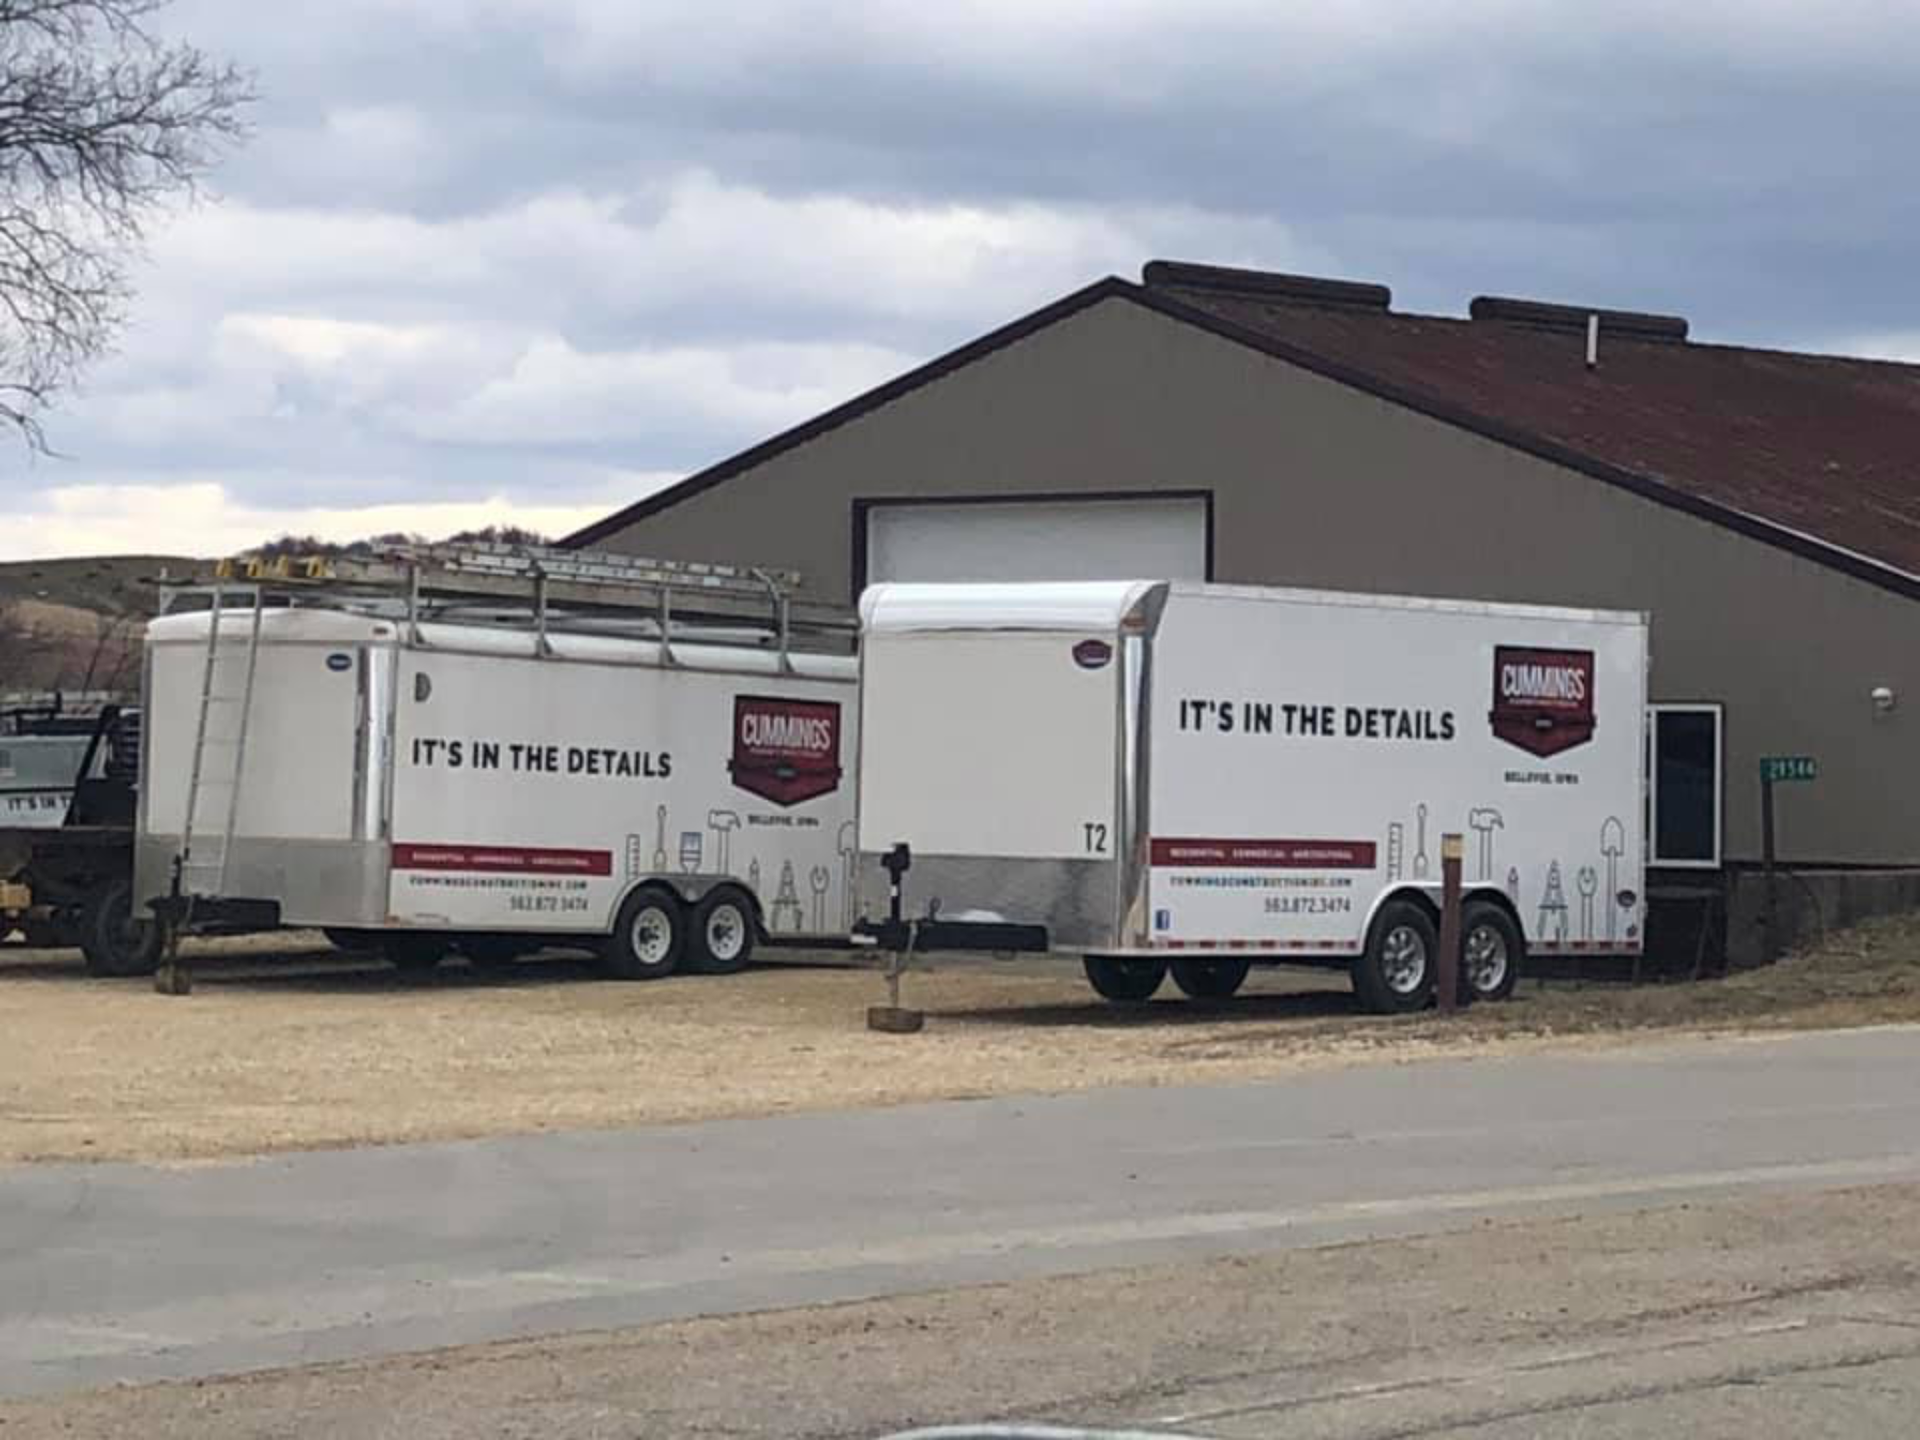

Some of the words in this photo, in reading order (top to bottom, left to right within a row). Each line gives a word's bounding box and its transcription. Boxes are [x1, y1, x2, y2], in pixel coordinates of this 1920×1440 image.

[1502, 665, 1585, 700] CUMMINGS
[741, 713, 831, 751] CUMMINGS
[1179, 699, 1234, 732] IT'S
[1244, 702, 1272, 733] IN
[1281, 704, 1336, 736] THE
[1345, 707, 1456, 740] DETAILS
[412, 738, 463, 768] IT'S
[472, 741, 500, 769] IN
[509, 744, 559, 772] THE
[567, 747, 673, 778] DETAILS
[1084, 823, 1107, 852] T2
[1264, 897, 1352, 913] 563.872.3474
